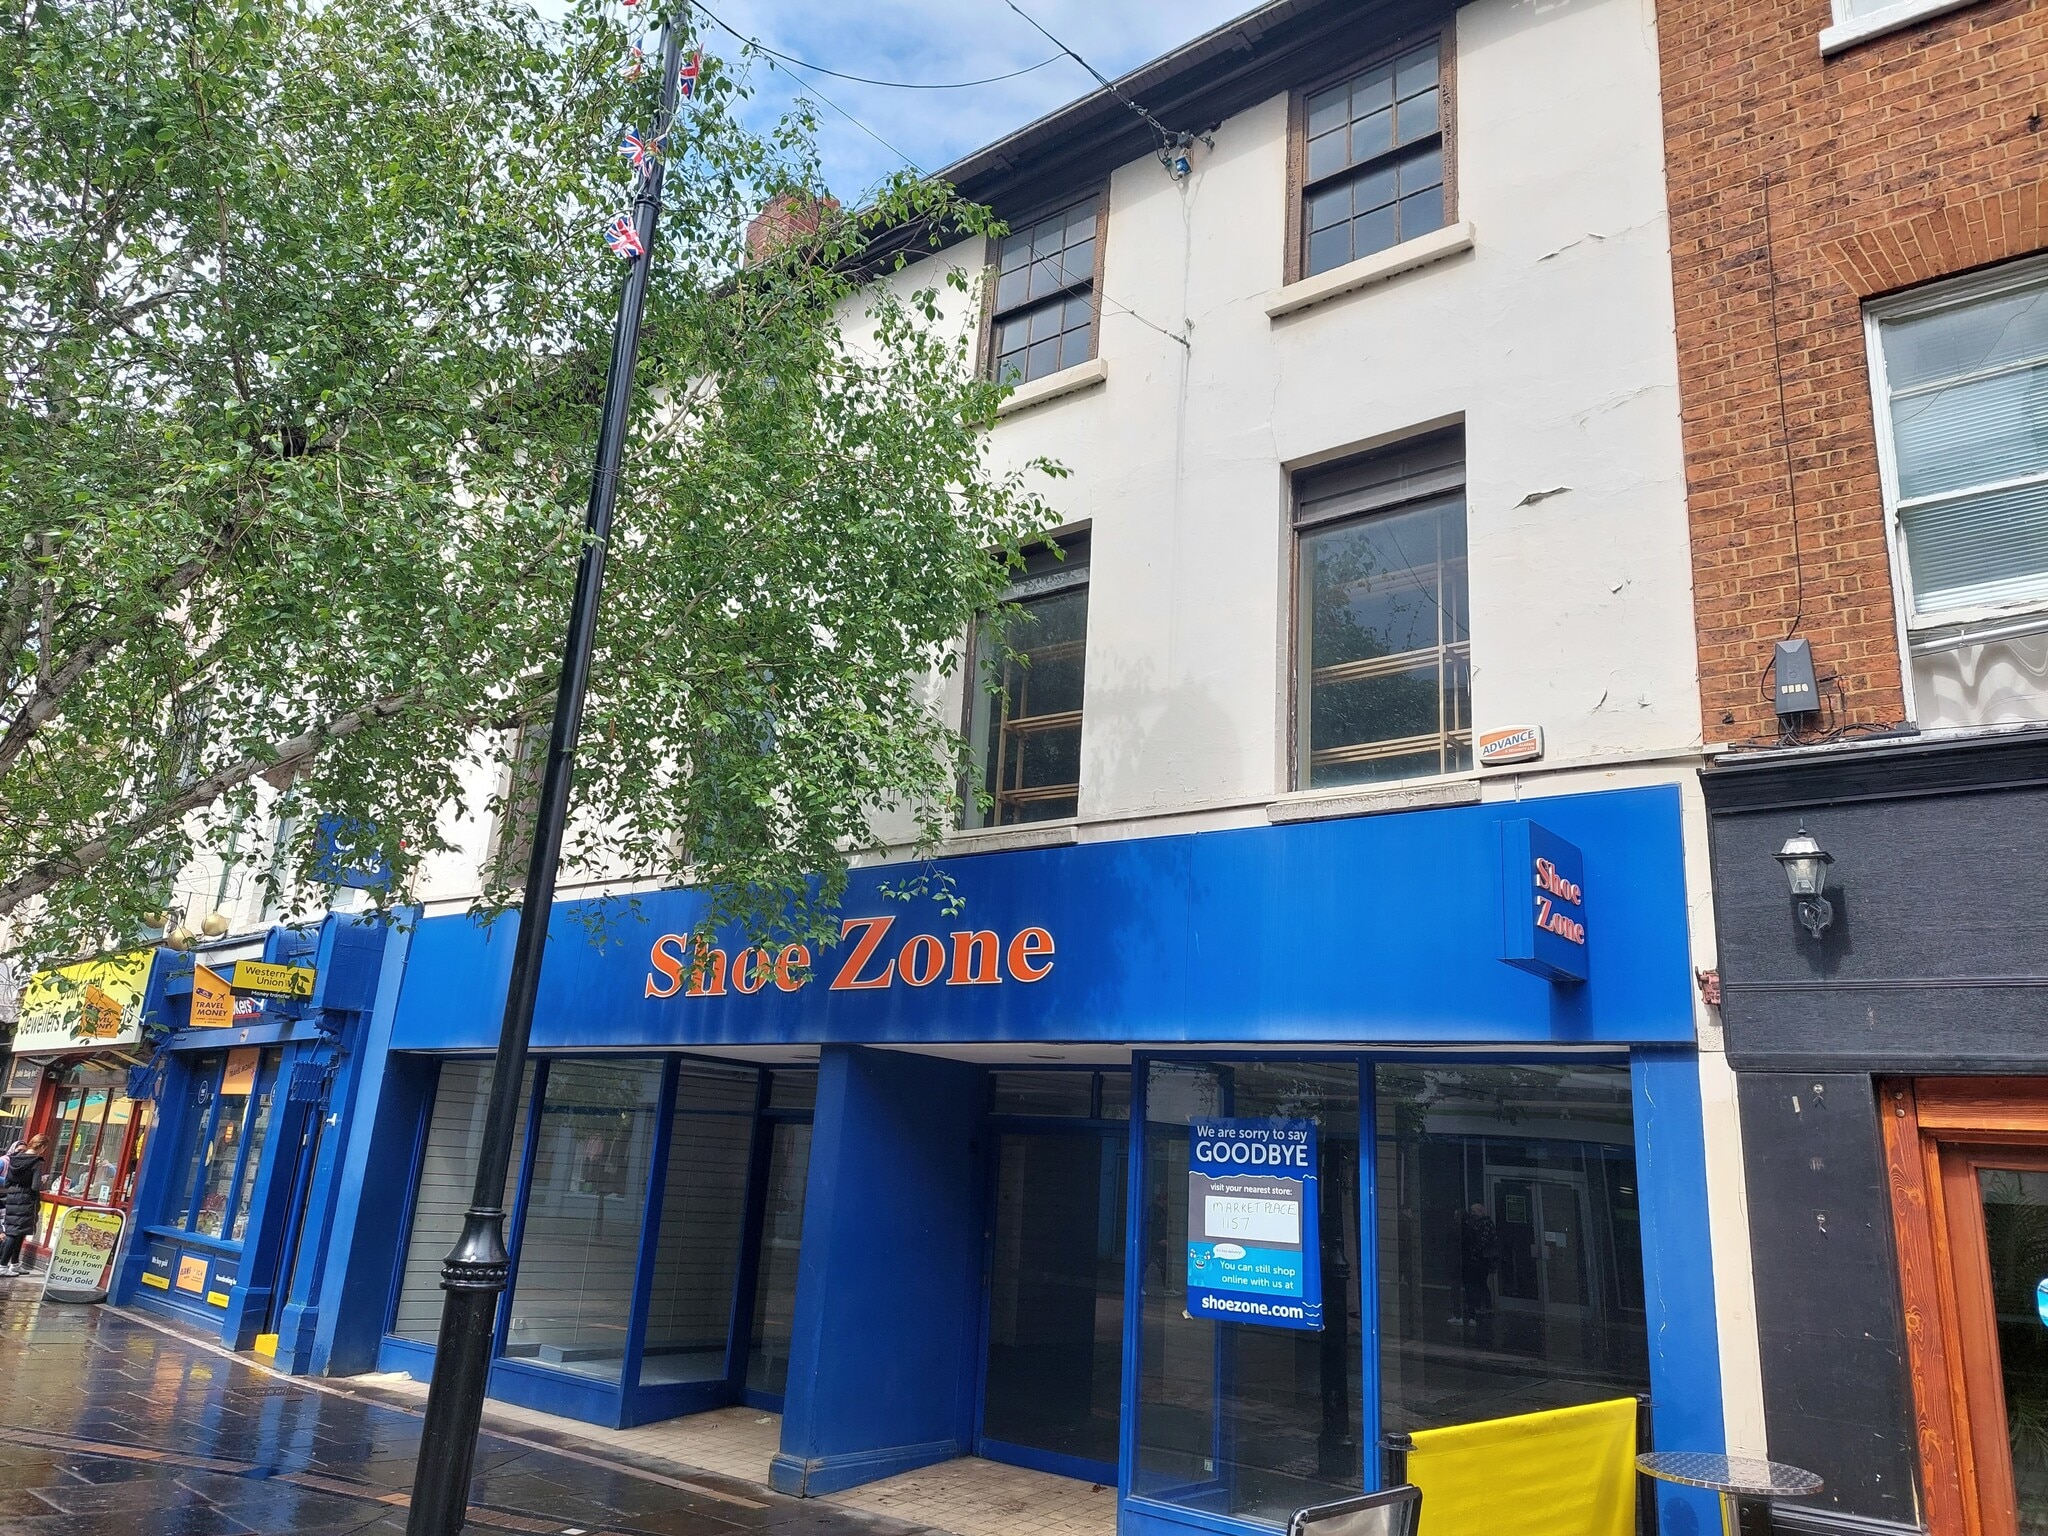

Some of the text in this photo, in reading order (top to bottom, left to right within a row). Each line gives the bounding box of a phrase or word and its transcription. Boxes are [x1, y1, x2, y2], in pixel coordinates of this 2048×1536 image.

[1482, 730, 1535, 755] ADVANCE
[1536, 857, 1581, 906] Shoe
[1536, 895, 1585, 945] Zone
[644, 915, 1056, 999] Shoe Zone
[245, 966, 286, 979] Western
[256, 976, 284, 988] Union
[251, 990, 291, 1000] Money transfer
[195, 1001, 224, 1009] TRAVEL
[196, 1008, 228, 1017] MONEY
[1197, 1125, 1307, 1143] We are sorry to say
[1196, 1141, 1309, 1167] GOODBYE
[1210, 1183, 1293, 1195] visit your nearest store:
[1213, 1202, 1297, 1215] MARKET PLACE
[1222, 1217, 1250, 1230] 1157
[61, 1248, 101, 1260] Best Price
[54, 1256, 71, 1265] Paid
[82, 1260, 103, 1269] Town
[1220, 1260, 1296, 1278] You can still shop
[60, 1265, 90, 1276] for your
[49, 1273, 94, 1285] Scrap Gold
[1221, 1275, 1294, 1290] online with us at
[1201, 1294, 1304, 1319] shoezone.com
